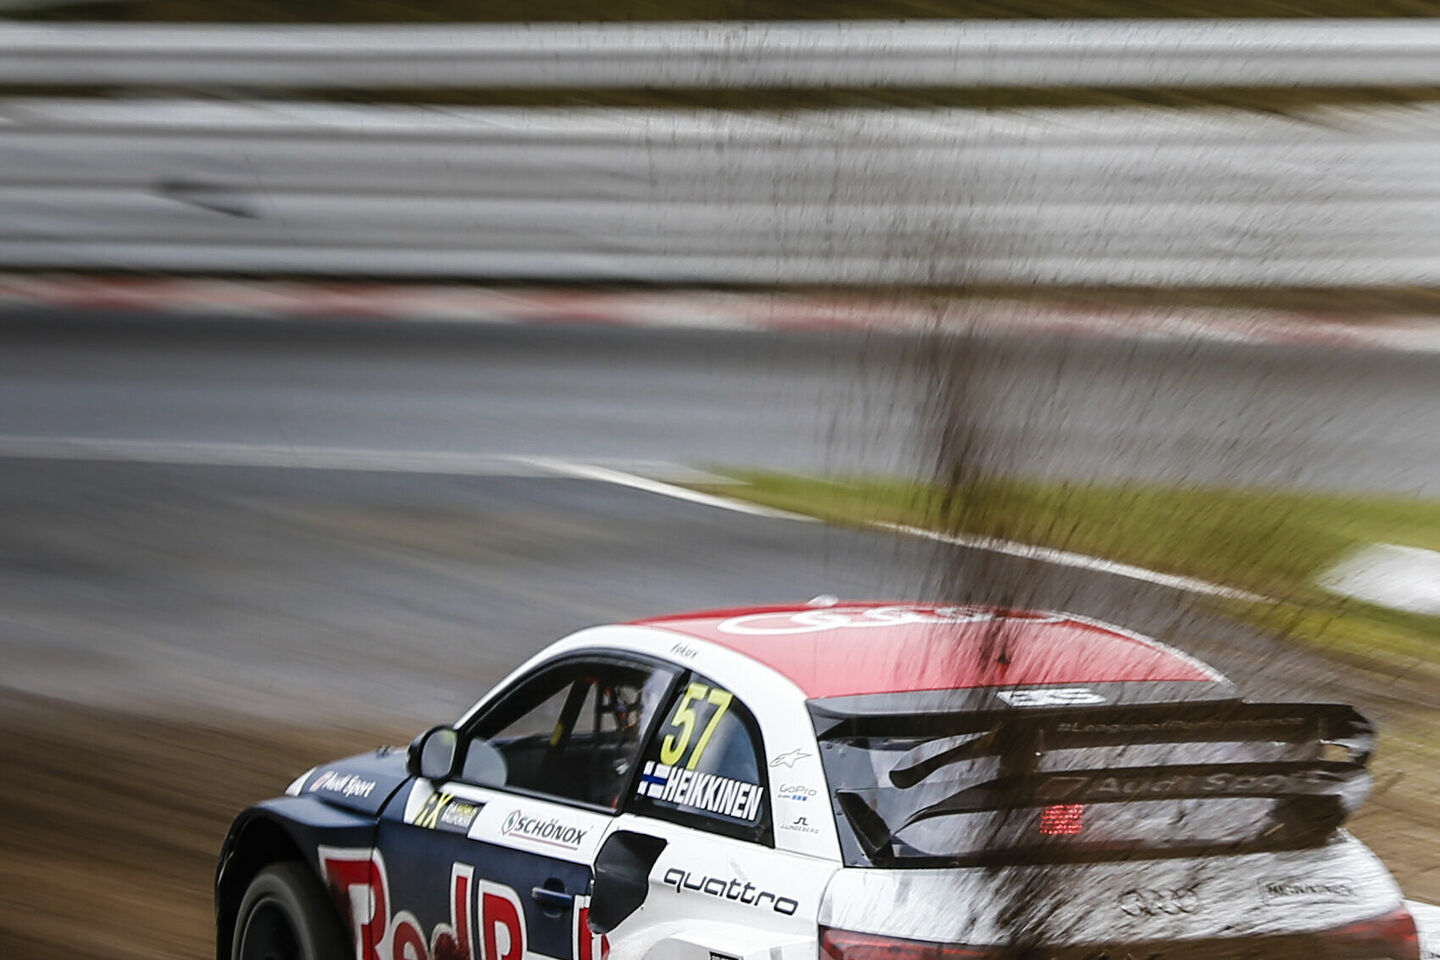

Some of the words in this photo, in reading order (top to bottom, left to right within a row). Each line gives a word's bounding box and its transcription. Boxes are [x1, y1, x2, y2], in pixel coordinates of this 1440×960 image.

[660, 682, 734, 771] 57
[661, 766, 764, 821] HEIKKINEN
[515, 816, 588, 846] SCHÖNOX
[663, 867, 799, 917] quattro
